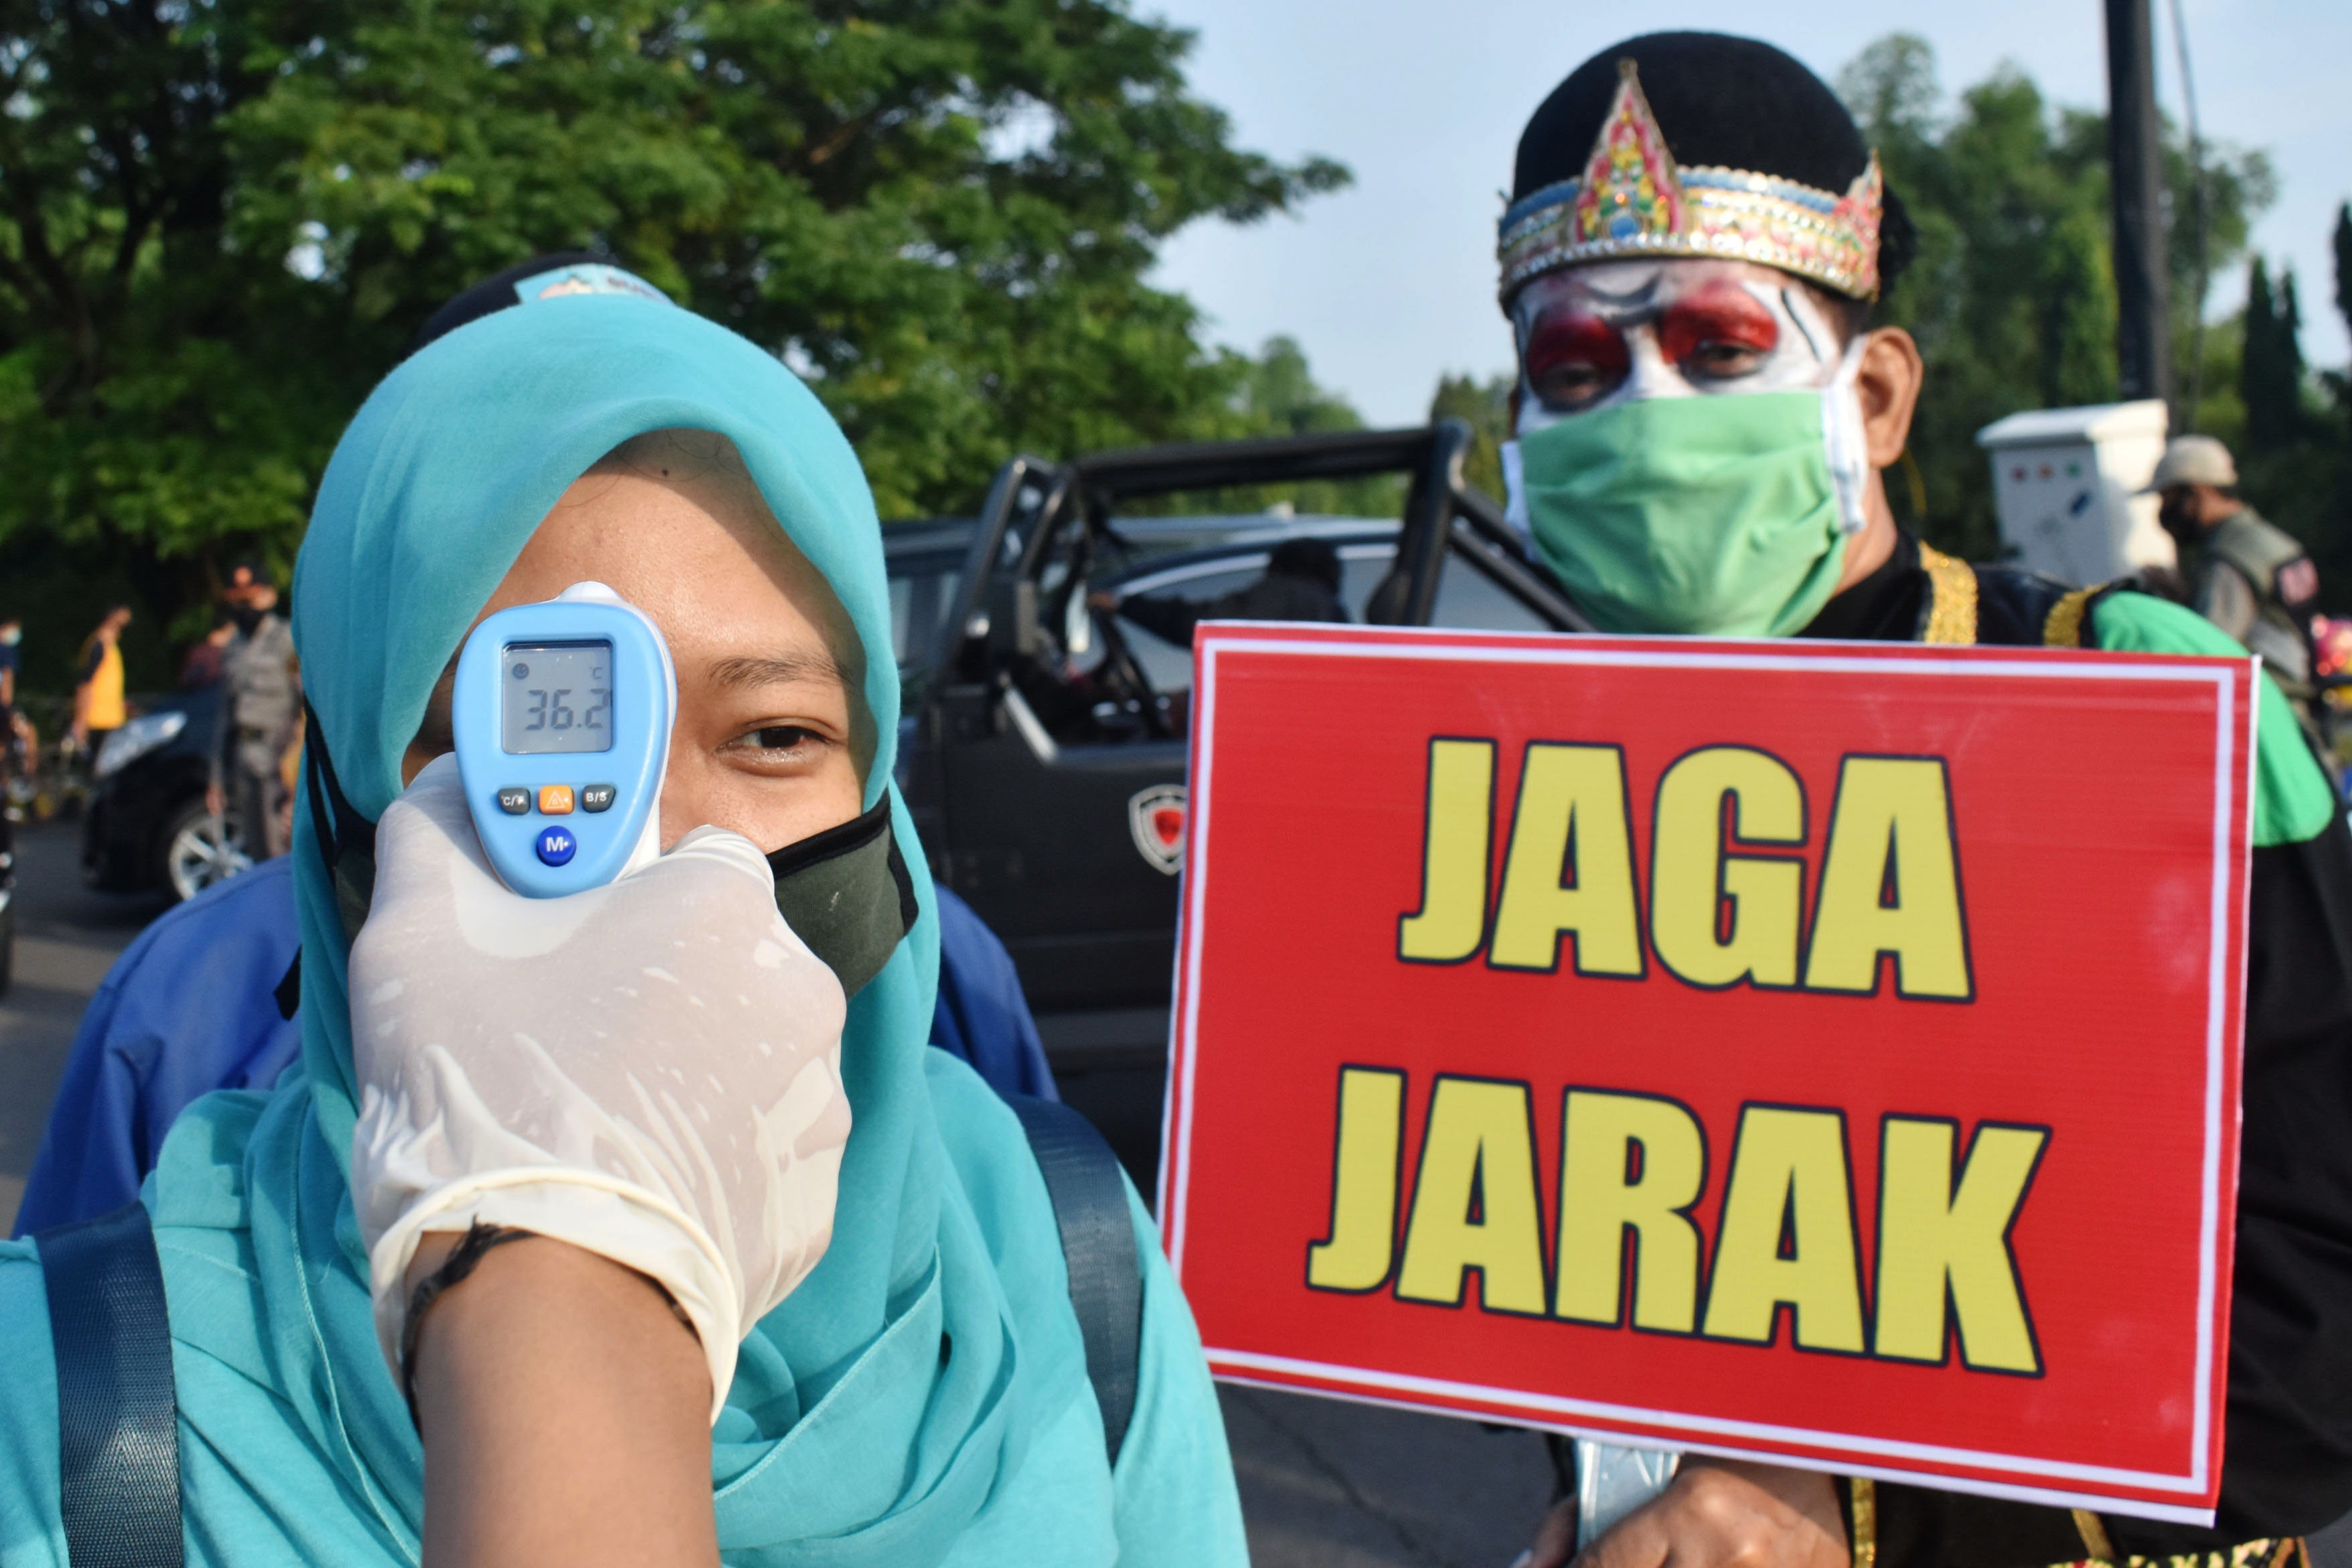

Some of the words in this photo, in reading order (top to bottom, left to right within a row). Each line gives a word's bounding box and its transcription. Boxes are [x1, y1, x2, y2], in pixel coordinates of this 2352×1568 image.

[526, 688, 610, 730] 36.2
[586, 791, 608, 802] B/S
[1397, 735, 1976, 1003] JAGA
[1305, 1062, 2053, 1378] JARAK
